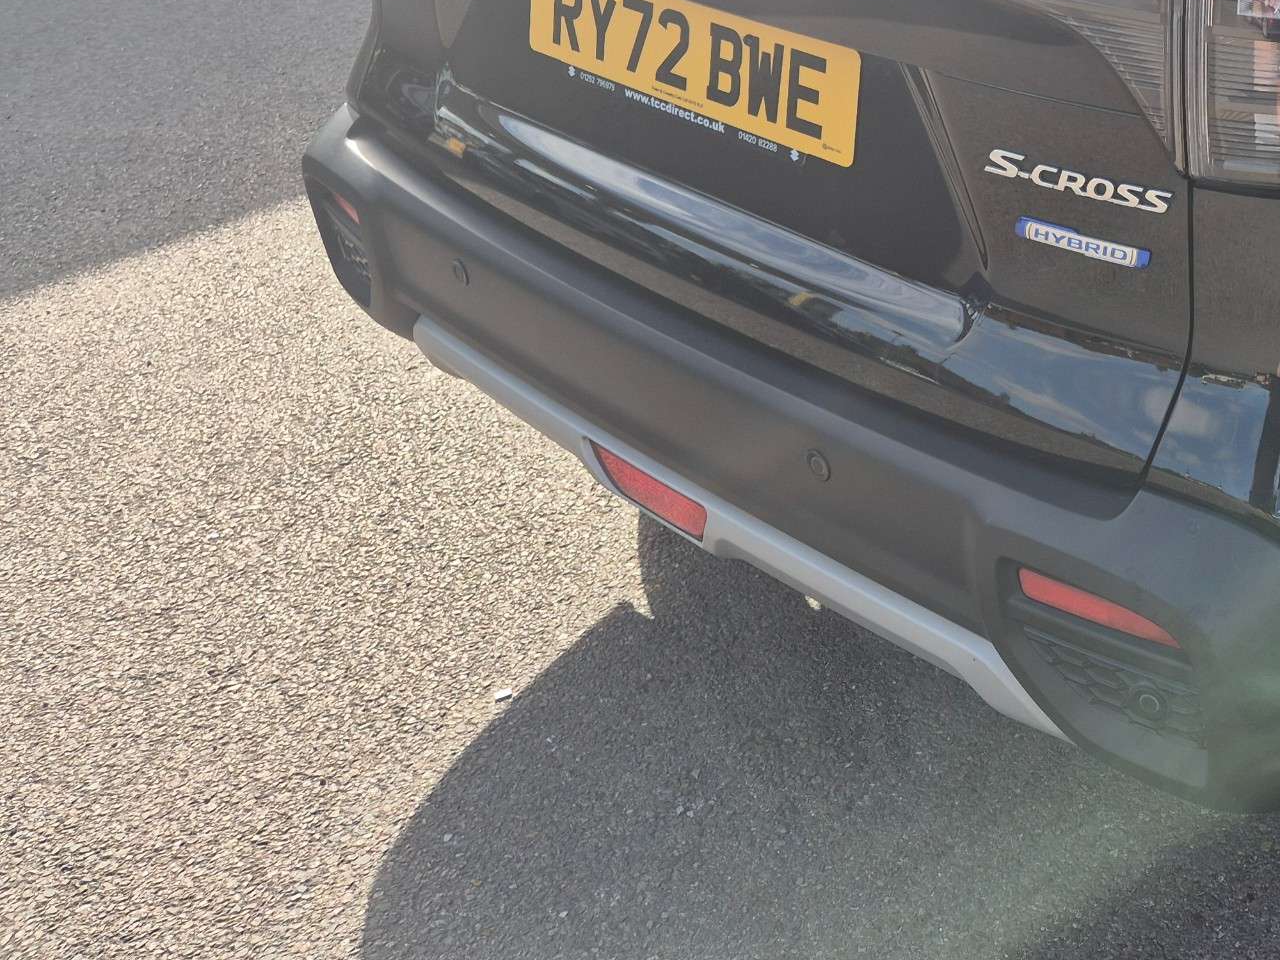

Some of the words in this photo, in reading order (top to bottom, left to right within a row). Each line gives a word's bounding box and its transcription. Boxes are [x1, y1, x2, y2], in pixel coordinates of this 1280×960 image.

[706, 21, 828, 141] BWE
[624, 87, 726, 134] www.tccdirect.co.uk
[983, 149, 1174, 215] S-CROSS
[1033, 226, 1128, 262] HYBRID
